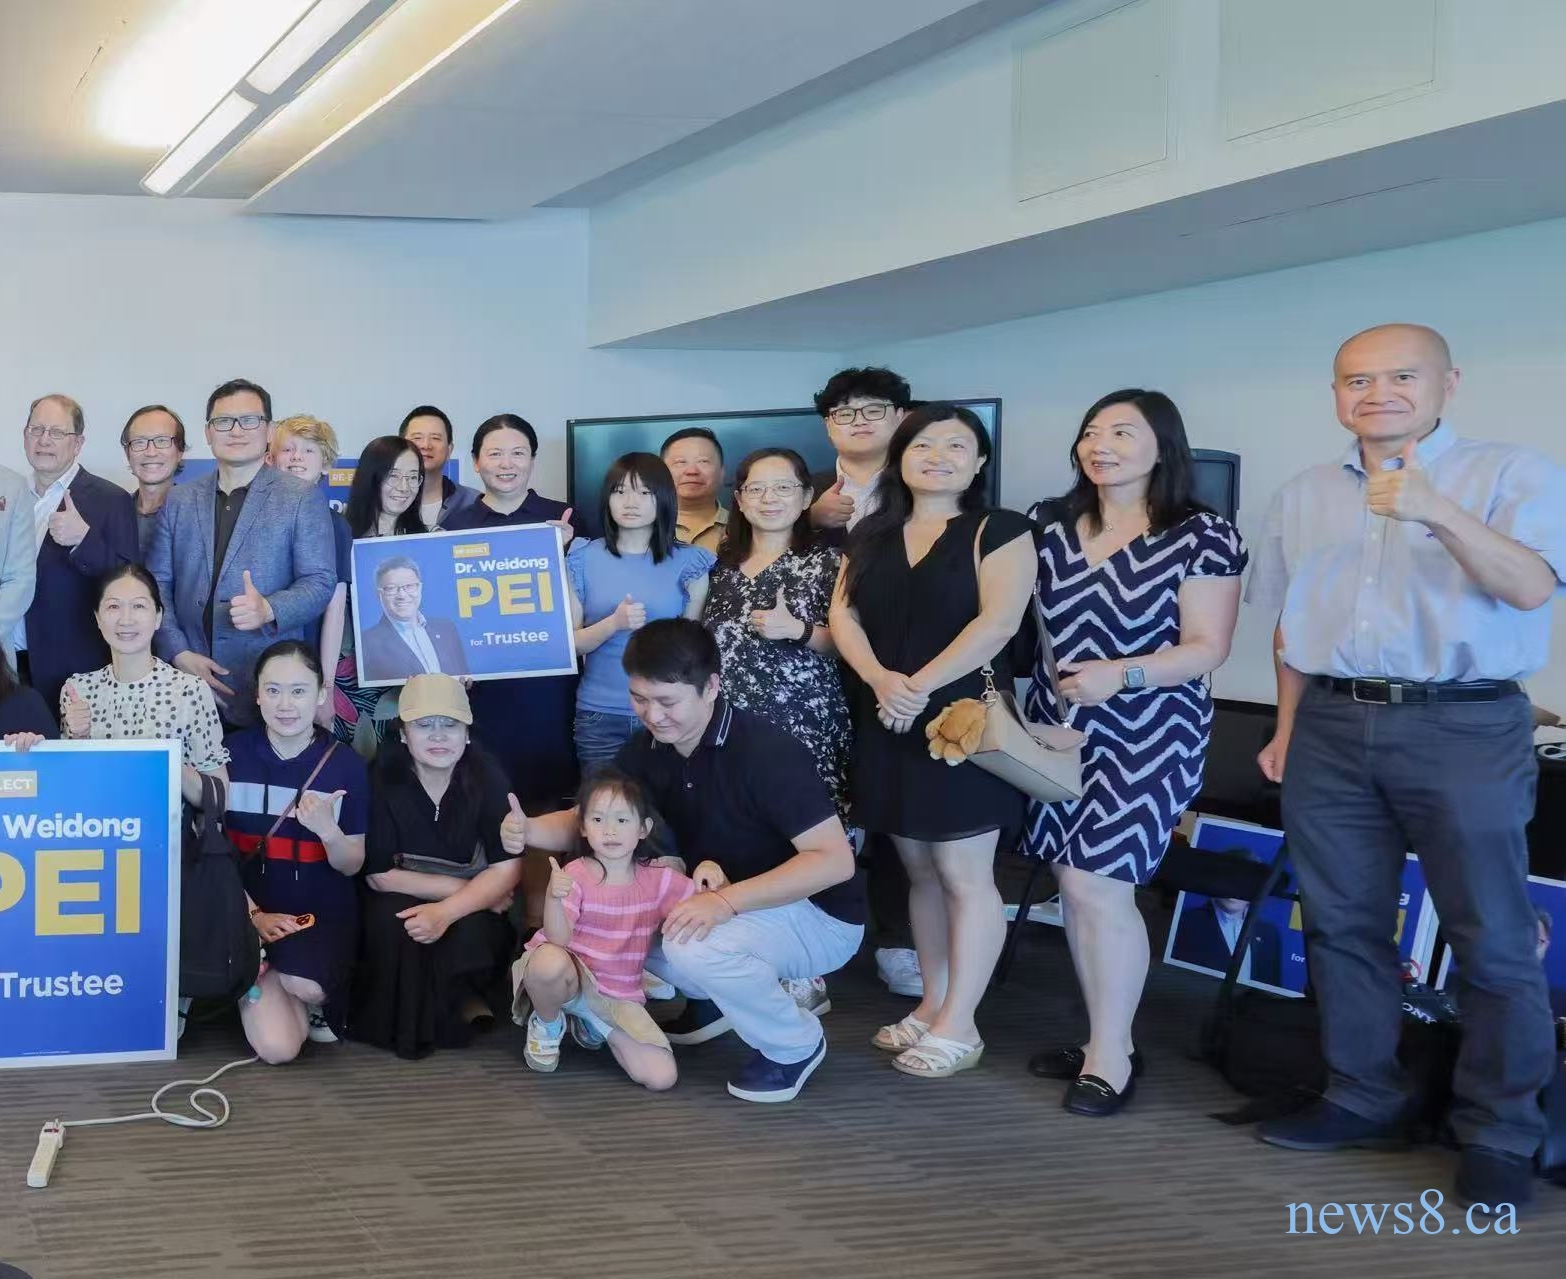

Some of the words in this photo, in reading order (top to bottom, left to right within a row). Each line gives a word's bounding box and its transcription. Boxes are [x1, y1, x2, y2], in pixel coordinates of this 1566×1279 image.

[331, 473, 354, 481] RE-E
[454, 559, 477, 575] Dr.
[479, 556, 549, 573] Weidong
[456, 571, 554, 618] PEI
[470, 638, 483, 647] for
[483, 629, 549, 646] Trustee
[2, 812, 141, 842] Weidong
[1402, 1001, 1438, 1024] ONY
